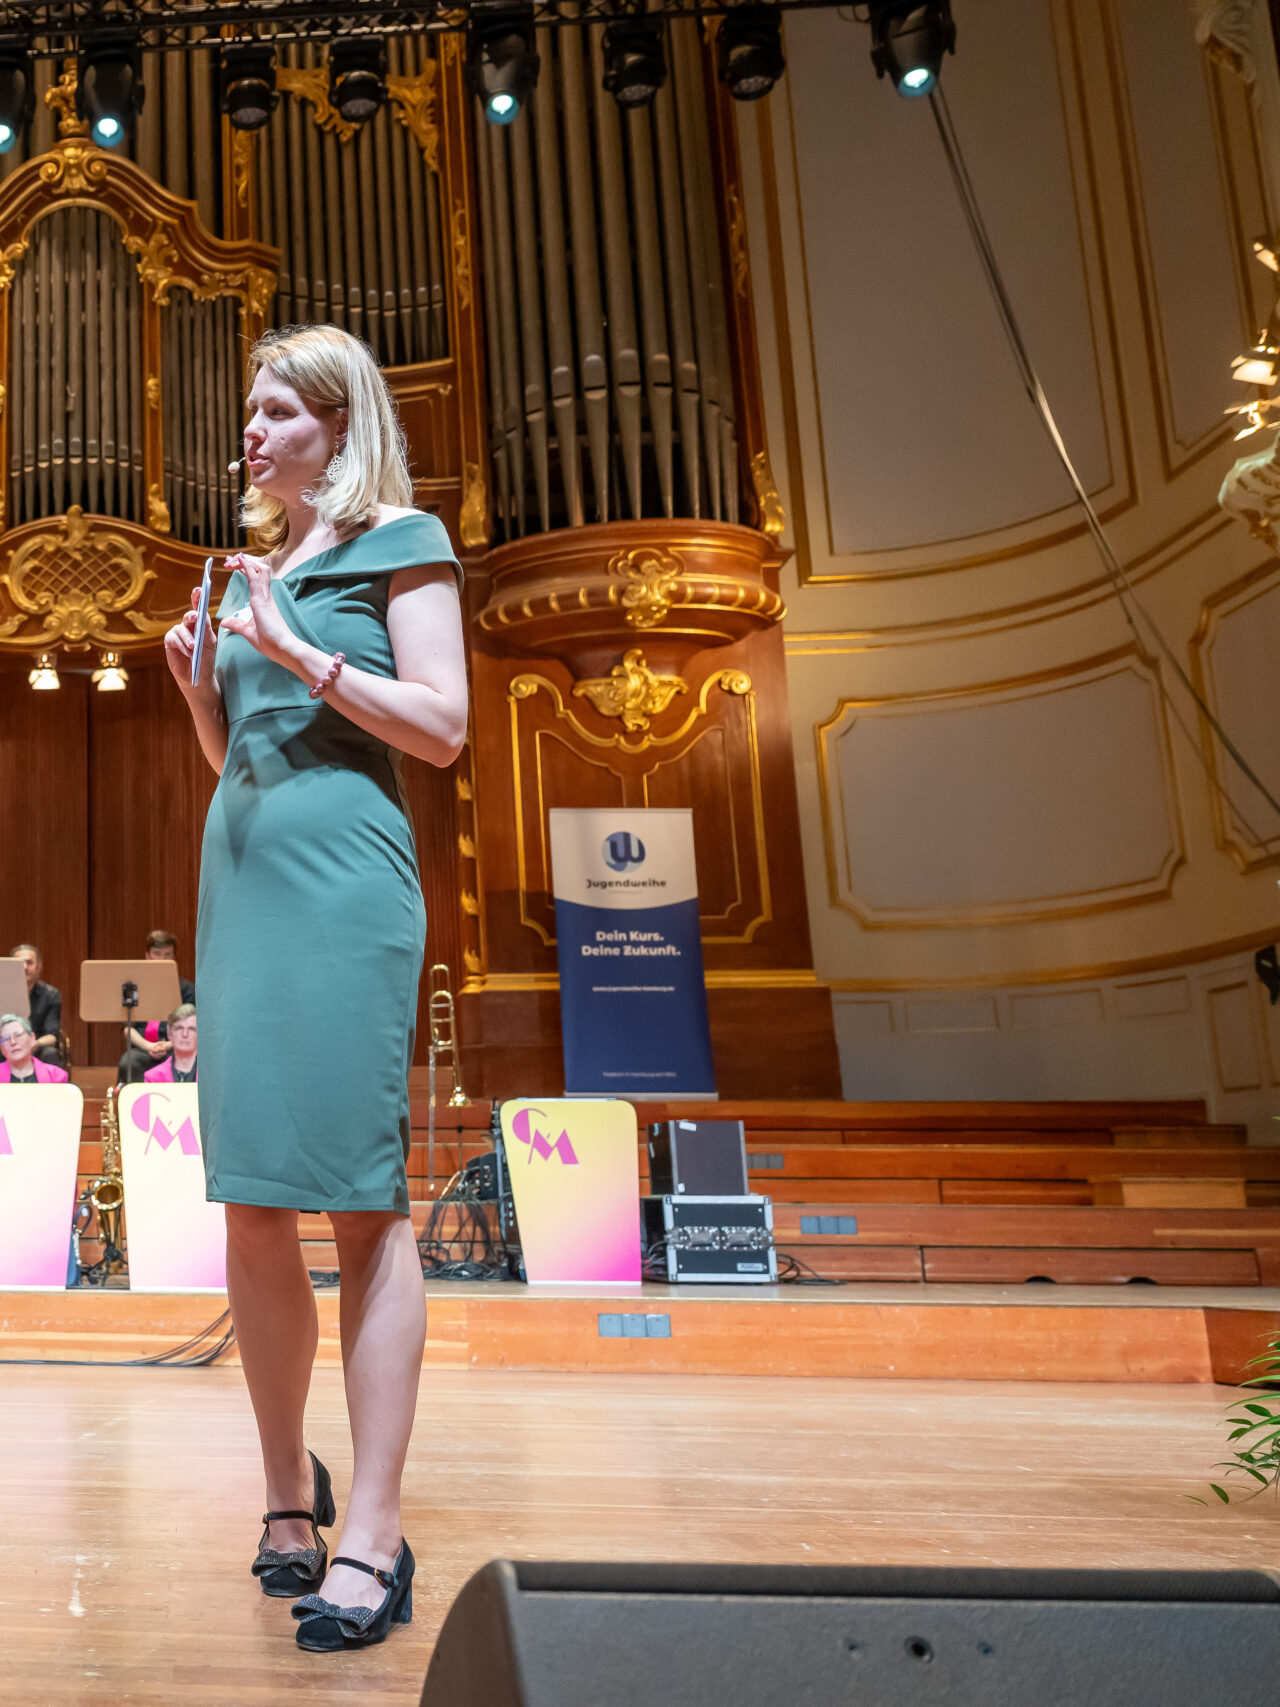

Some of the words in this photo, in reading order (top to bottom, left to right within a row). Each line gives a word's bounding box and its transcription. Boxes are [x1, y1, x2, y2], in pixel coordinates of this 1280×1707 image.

[586, 878, 667, 889] Jugendweihe
[595, 930, 627, 941] Dein
[629, 930, 665, 941] Kurs.
[581, 944, 620, 956] Deine
[623, 944, 681, 956] Zukunft.
